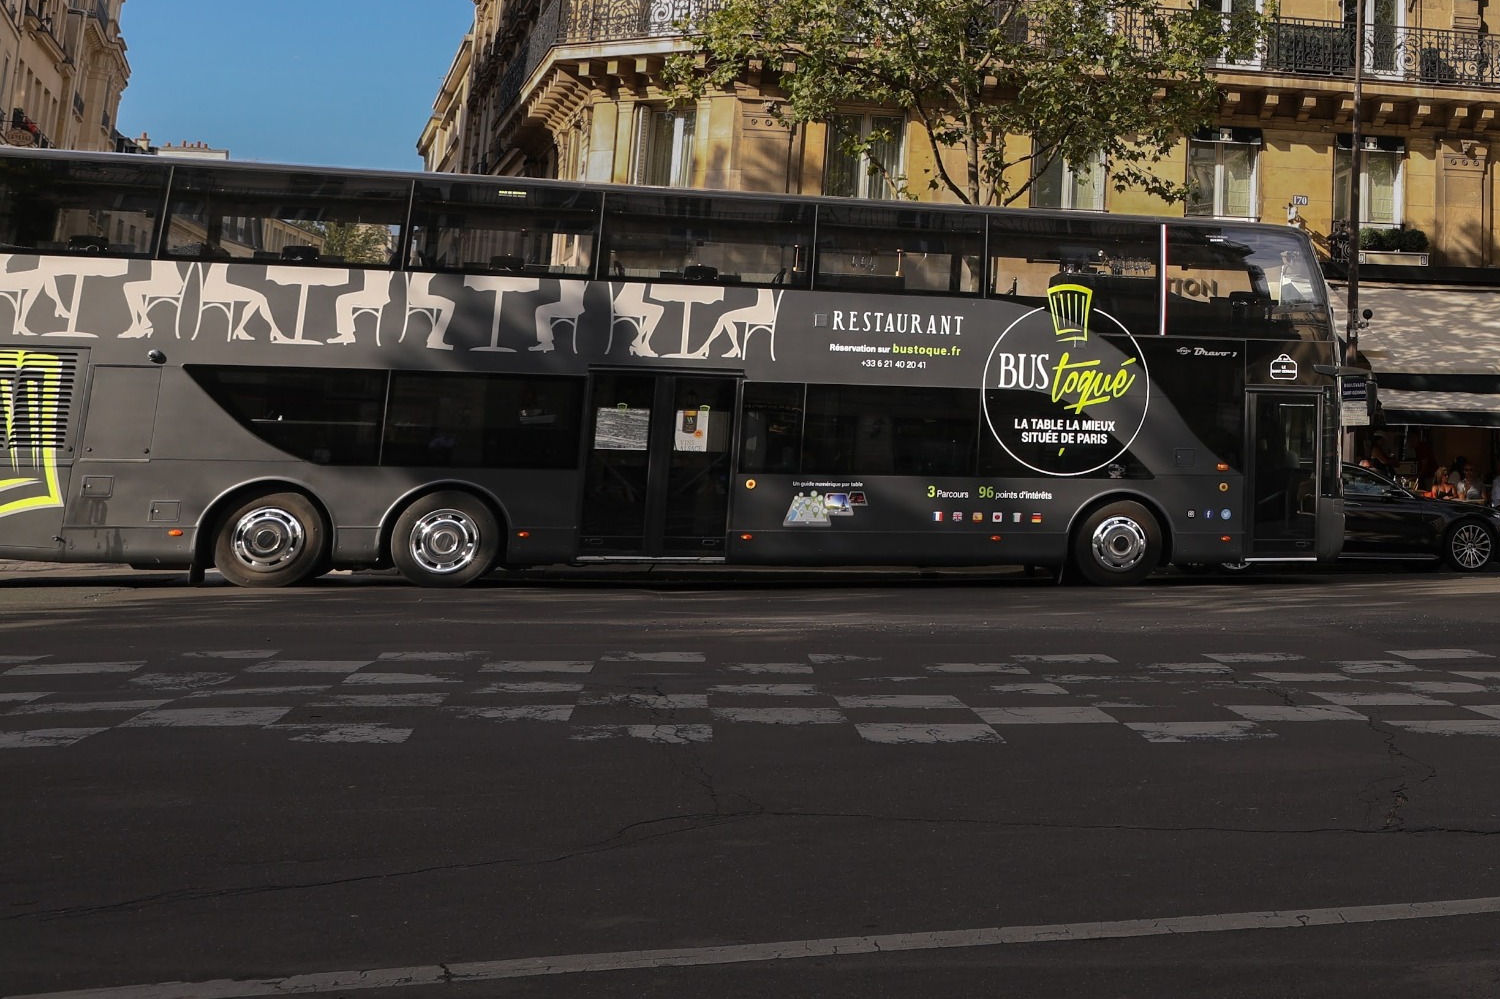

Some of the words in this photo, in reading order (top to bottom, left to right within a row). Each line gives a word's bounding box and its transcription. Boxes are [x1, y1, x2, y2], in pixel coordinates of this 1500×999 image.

[1294, 196, 1306, 205] 170
[832, 310, 964, 336] RESTAURANT
[830, 343, 876, 354] Réservation
[892, 343, 961, 357] bustoque.fr
[1194, 347, 1230, 356] Bravo
[861, 360, 876, 368] +33
[884, 360, 893, 368] 21
[917, 361, 926, 369] 41
[998, 353, 1049, 390] BUS
[1052, 352, 1136, 414] toqué
[1014, 418, 1029, 430] LA
[1031, 418, 1064, 430] TABLE
[1066, 420, 1080, 431] LA
[1082, 420, 1116, 432] MIEUX
[1021, 430, 1058, 444] SITUÉE
[1061, 432, 1075, 444] DE
[1077, 433, 1108, 444] PARIS
[927, 485, 935, 498] 3
[937, 489, 969, 498] Parcours
[978, 486, 994, 498] 96
[995, 490, 1017, 500] points
[1019, 490, 1052, 500] d'intérêts
